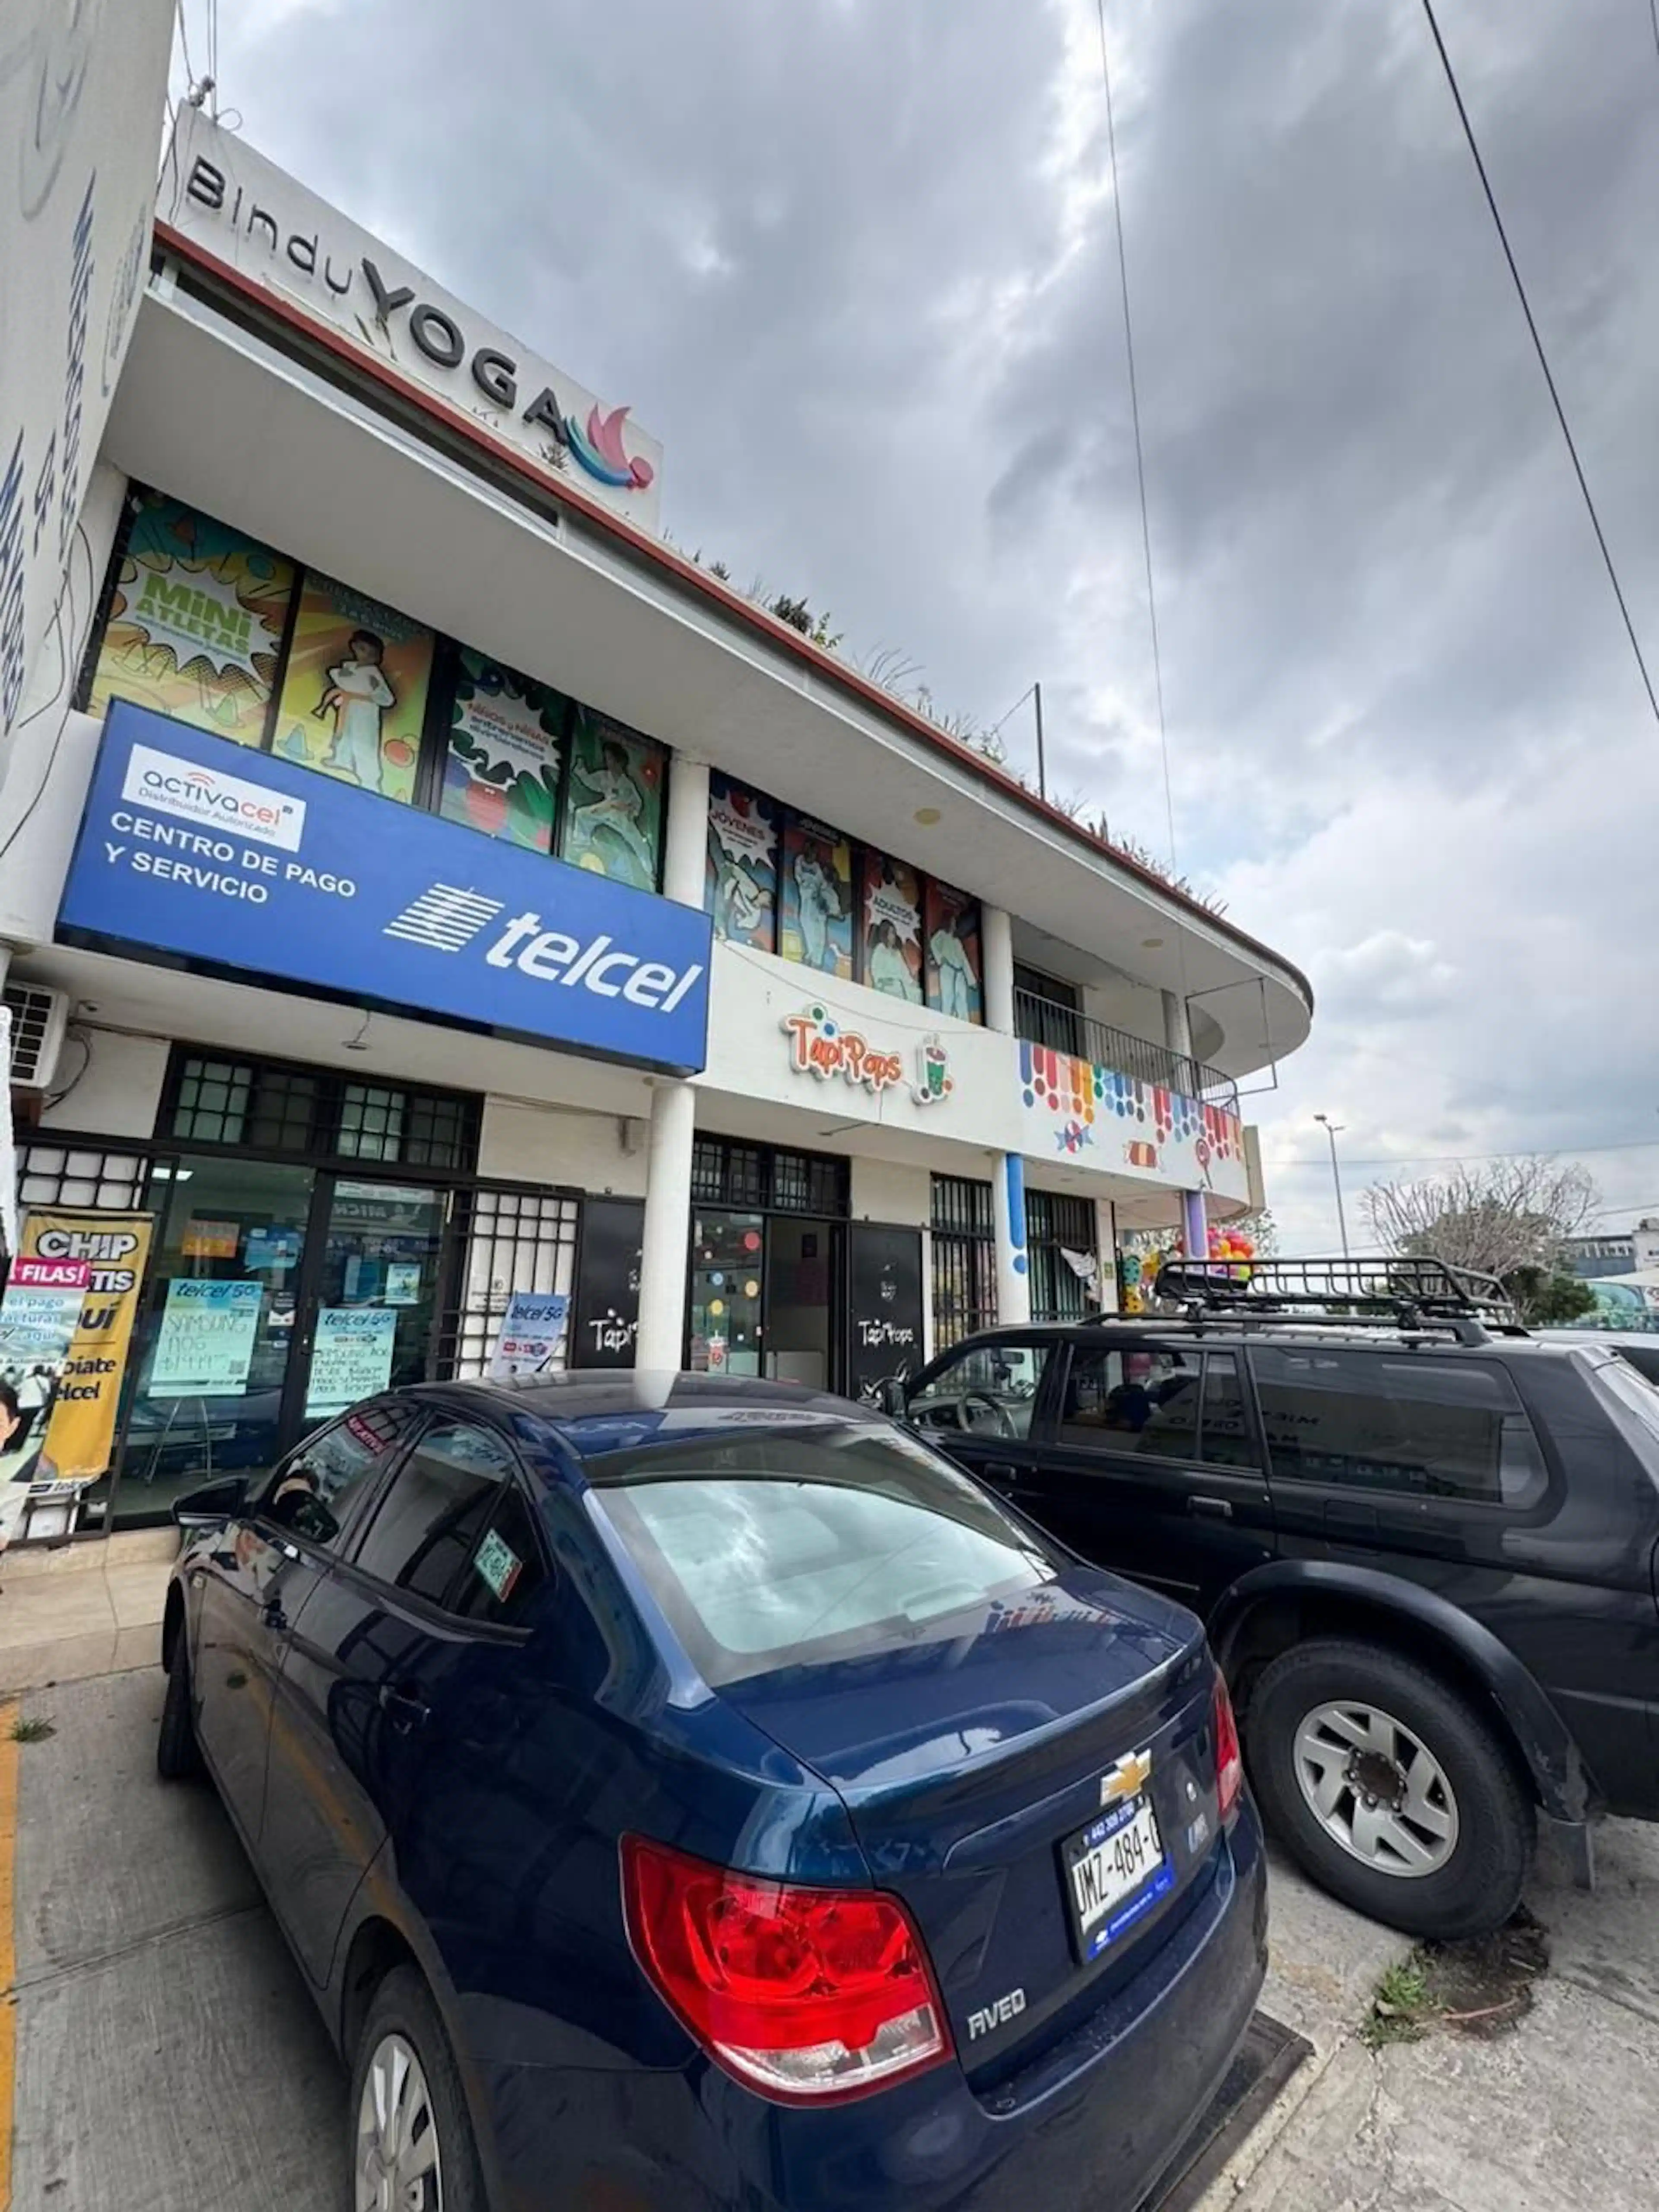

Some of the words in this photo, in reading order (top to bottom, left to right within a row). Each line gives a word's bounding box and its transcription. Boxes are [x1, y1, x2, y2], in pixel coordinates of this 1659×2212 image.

[362, 257, 569, 446] YOGA
[104, 842, 126, 864] Y
[131, 852, 268, 904] SERVICIO
[110, 810, 235, 863] CENTRO
[241, 849, 278, 877] DE
[285, 863, 357, 898] PAGO
[486, 912, 704, 1014] telcel
[21, 1263, 85, 1284] FILAS!
[37, 1229, 138, 1261] CHIP
[176, 1282, 232, 1299] telcel
[967, 1987, 1026, 2040] AVEO
